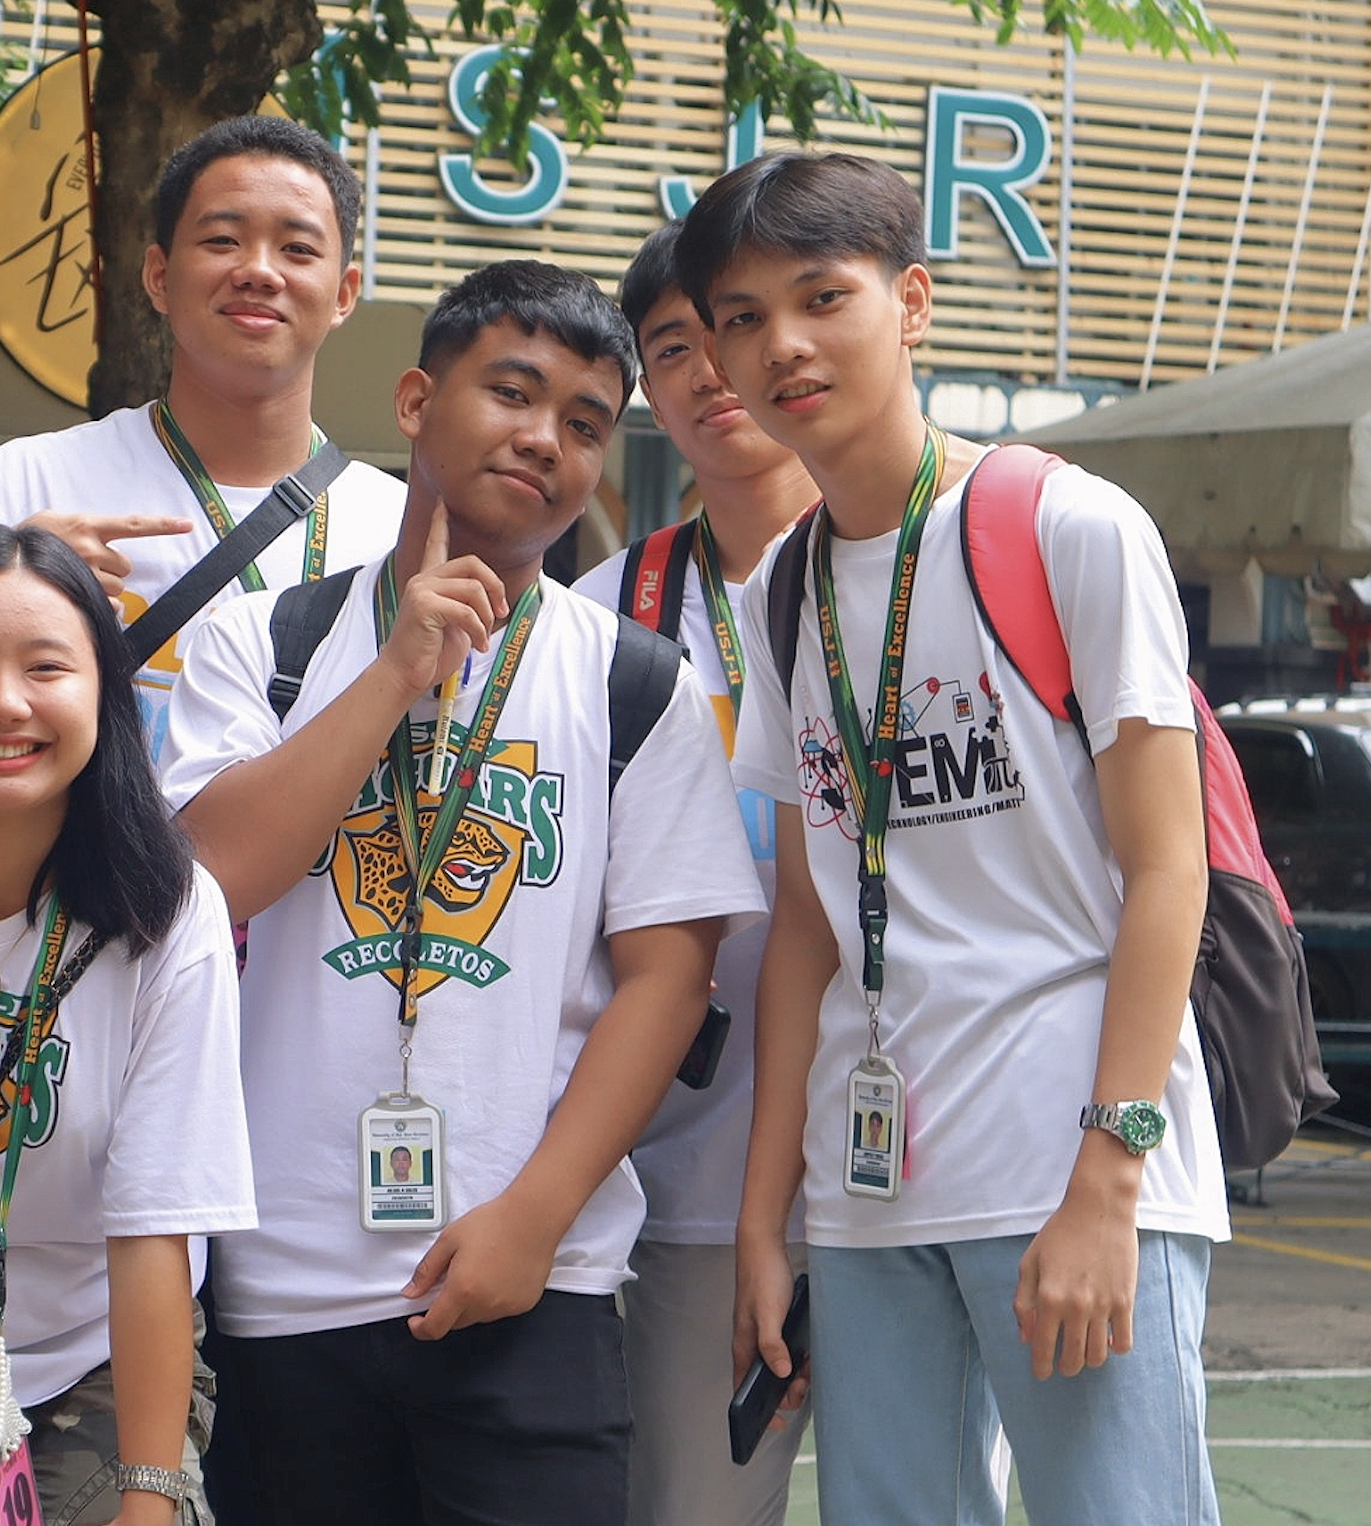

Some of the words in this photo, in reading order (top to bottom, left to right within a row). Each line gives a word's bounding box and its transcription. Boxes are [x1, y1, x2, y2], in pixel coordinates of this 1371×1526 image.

[310, 490, 327, 551] Excelle
[638, 569, 659, 612] FILA
[887, 552, 916, 658] Excellence
[468, 704, 499, 753] Heart
[493, 616, 532, 689] Excellence
[878, 685, 899, 740] Heart
[24, 1009, 44, 1063] Heart
[39, 911, 67, 986] Excellen
[2, 1471, 34, 1526] 19
